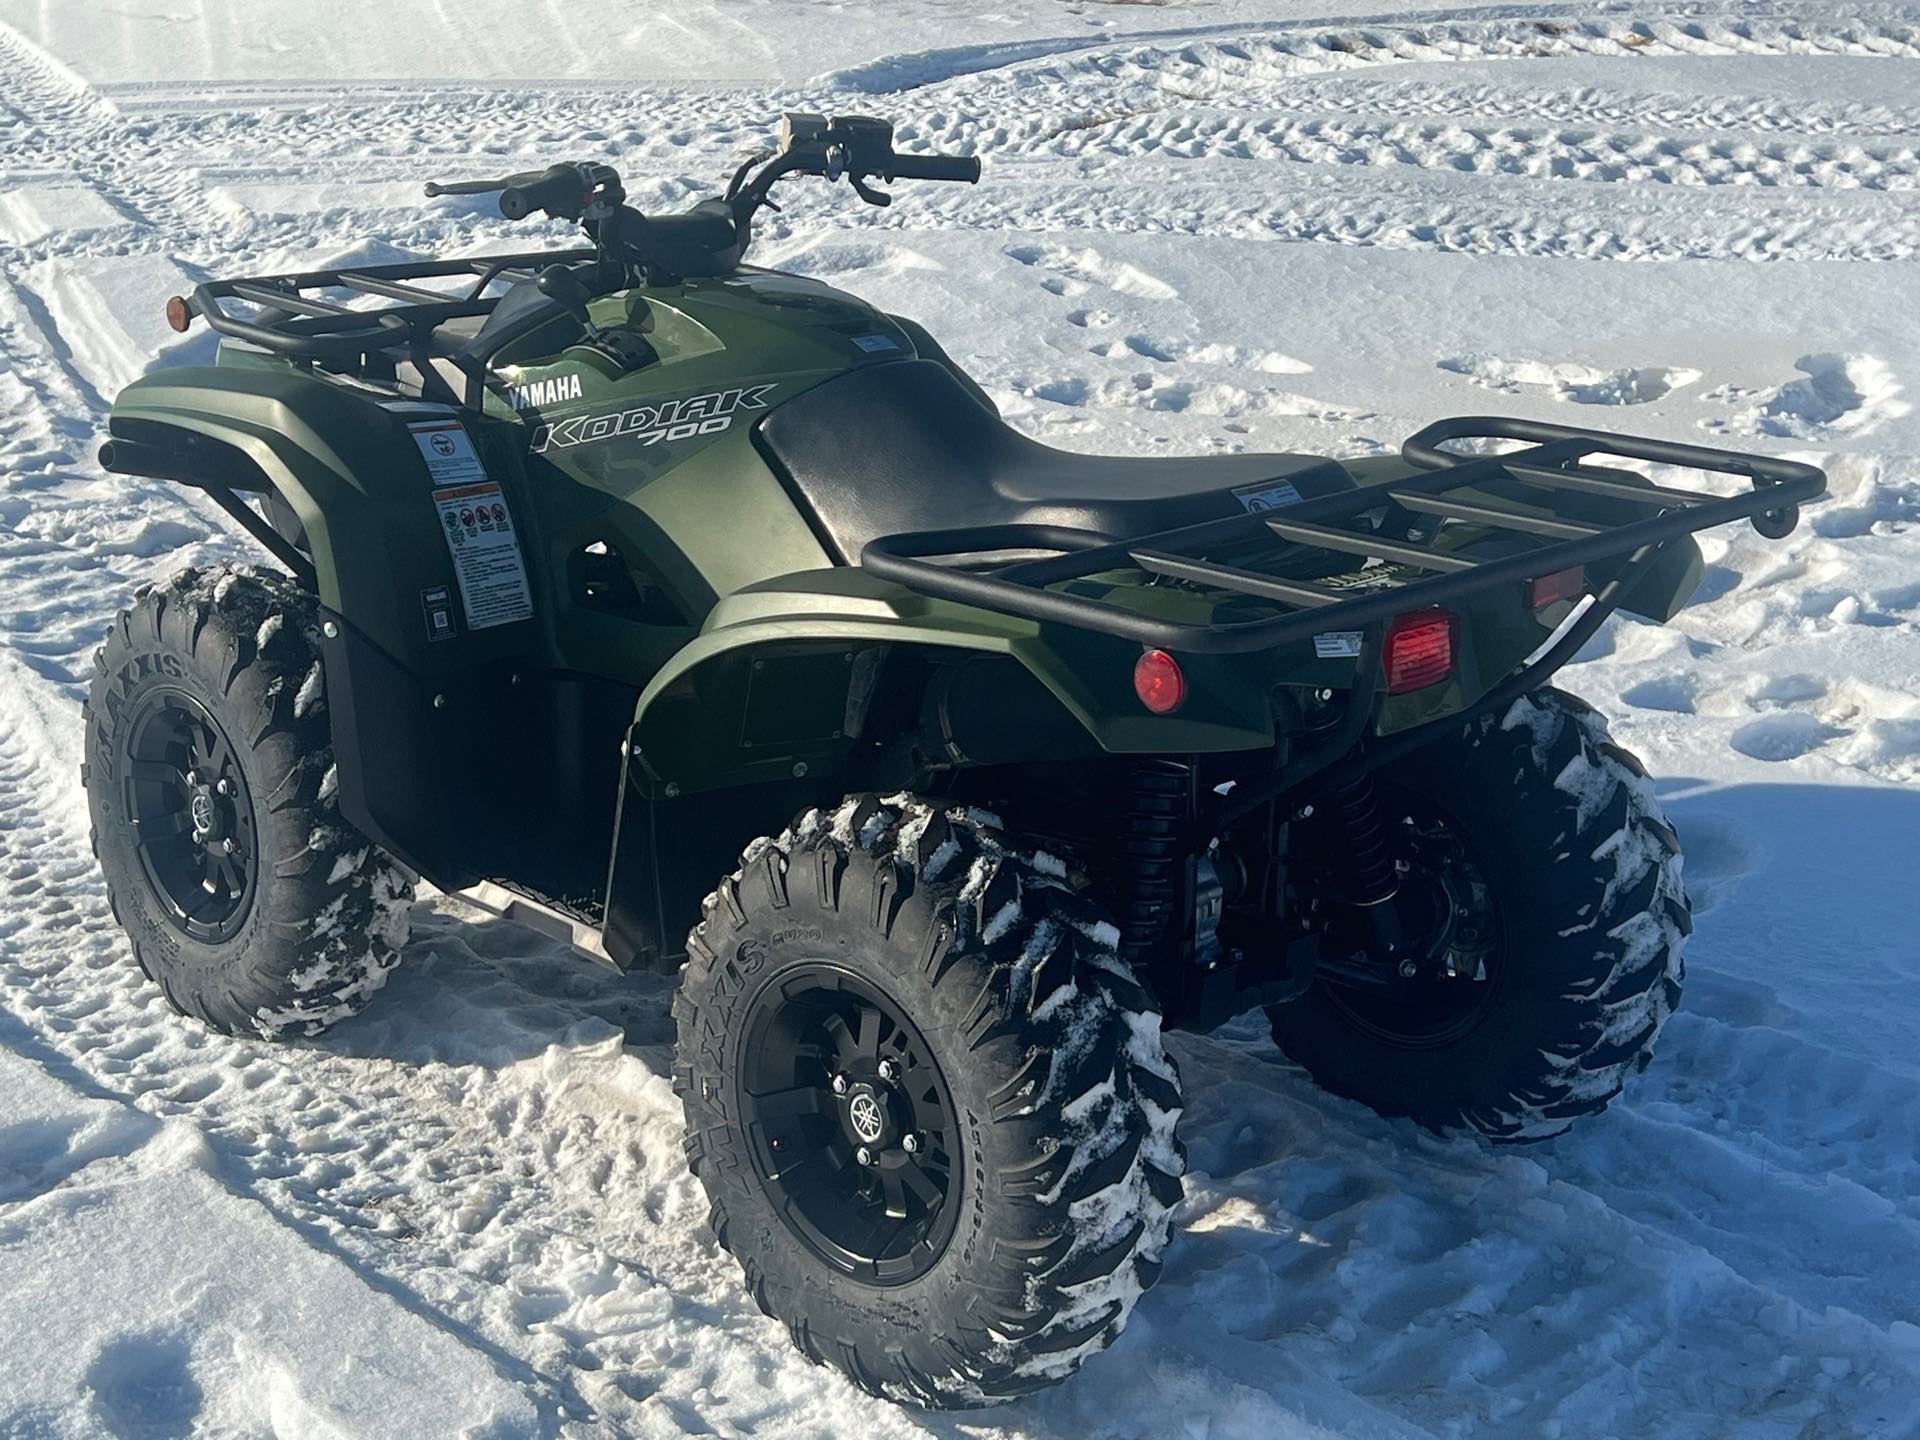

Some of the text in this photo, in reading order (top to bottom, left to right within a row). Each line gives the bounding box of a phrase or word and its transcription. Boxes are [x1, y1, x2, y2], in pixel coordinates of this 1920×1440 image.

[509, 374, 583, 410] YAMAHA
[529, 383, 780, 454] KODIAK
[637, 416, 732, 447] 700
[700, 938, 766, 1197] MAXXIS
